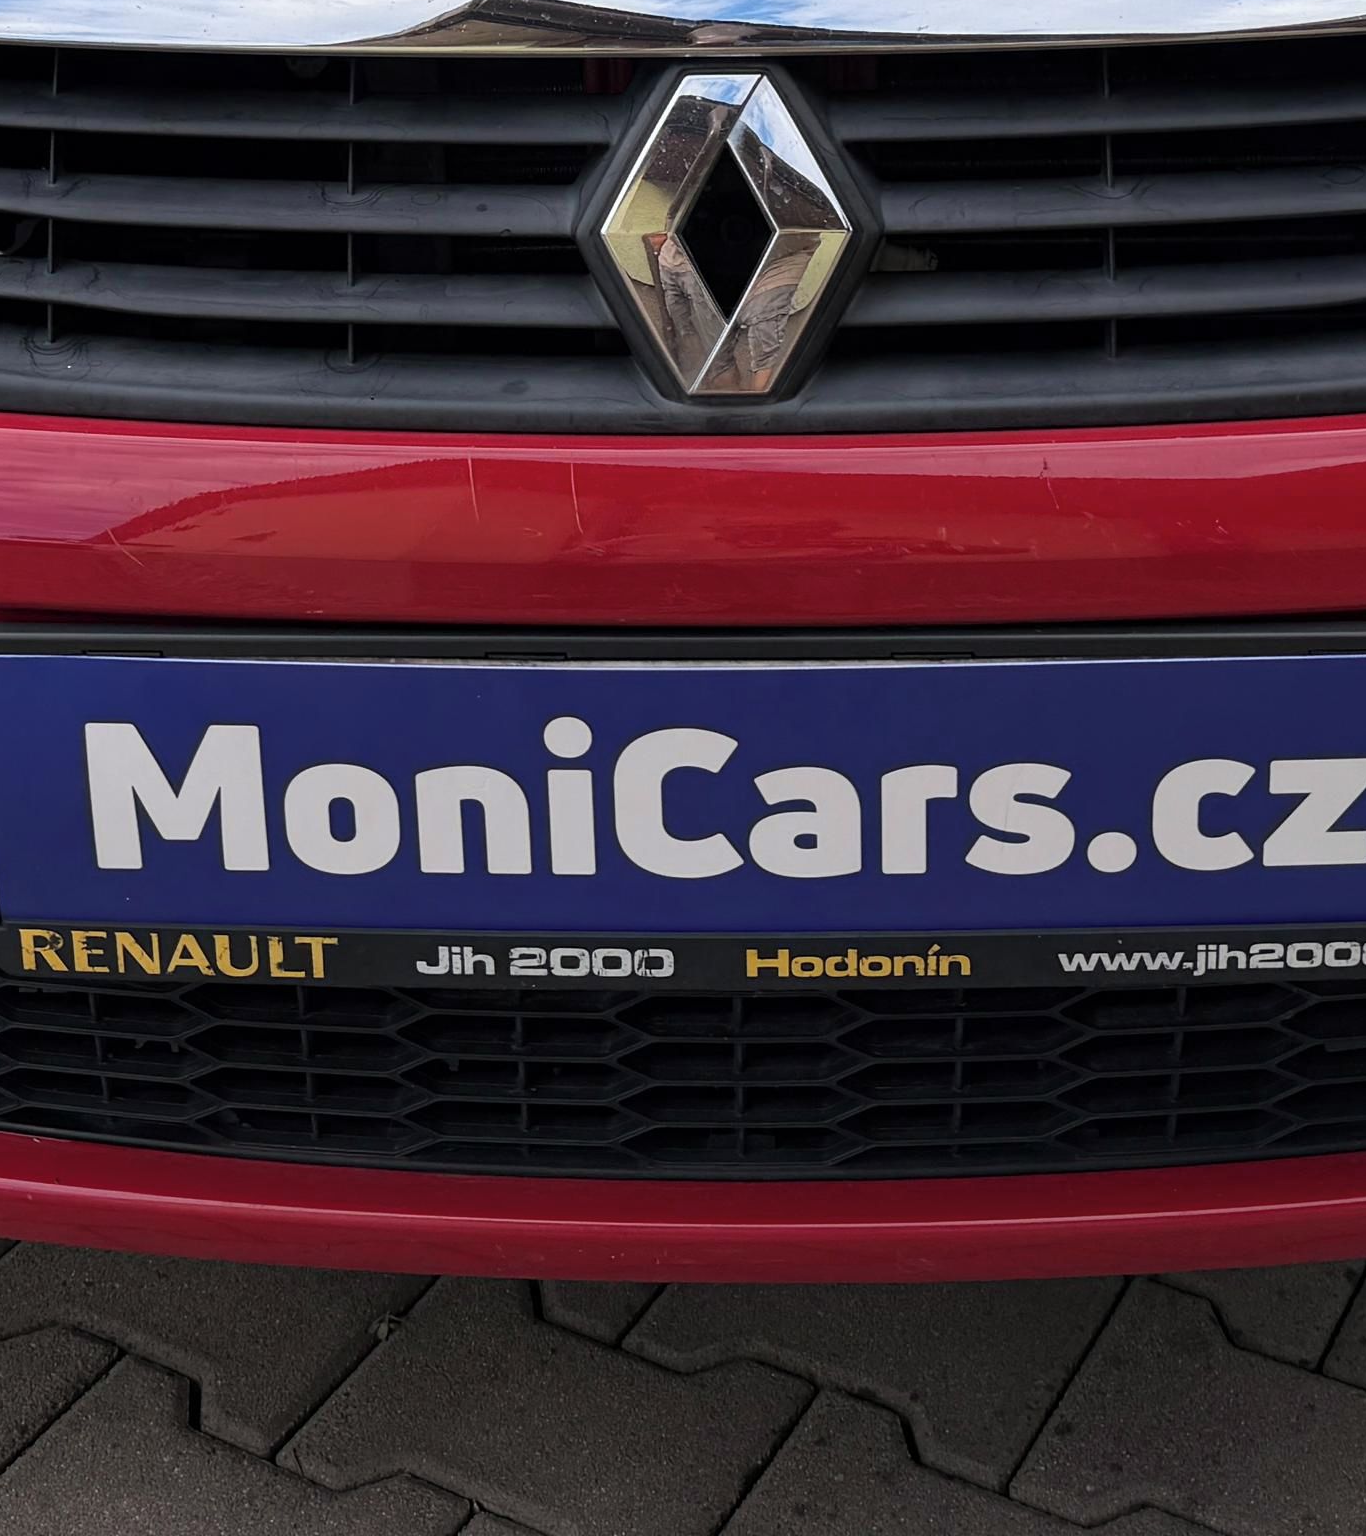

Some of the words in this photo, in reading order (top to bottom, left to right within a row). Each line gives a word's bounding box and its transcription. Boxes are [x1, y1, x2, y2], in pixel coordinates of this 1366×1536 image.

[18, 928, 338, 979] RENAULT
[416, 945, 495, 977] Jih
[509, 947, 675, 978] 2000
[745, 944, 972, 978] Hodonín
